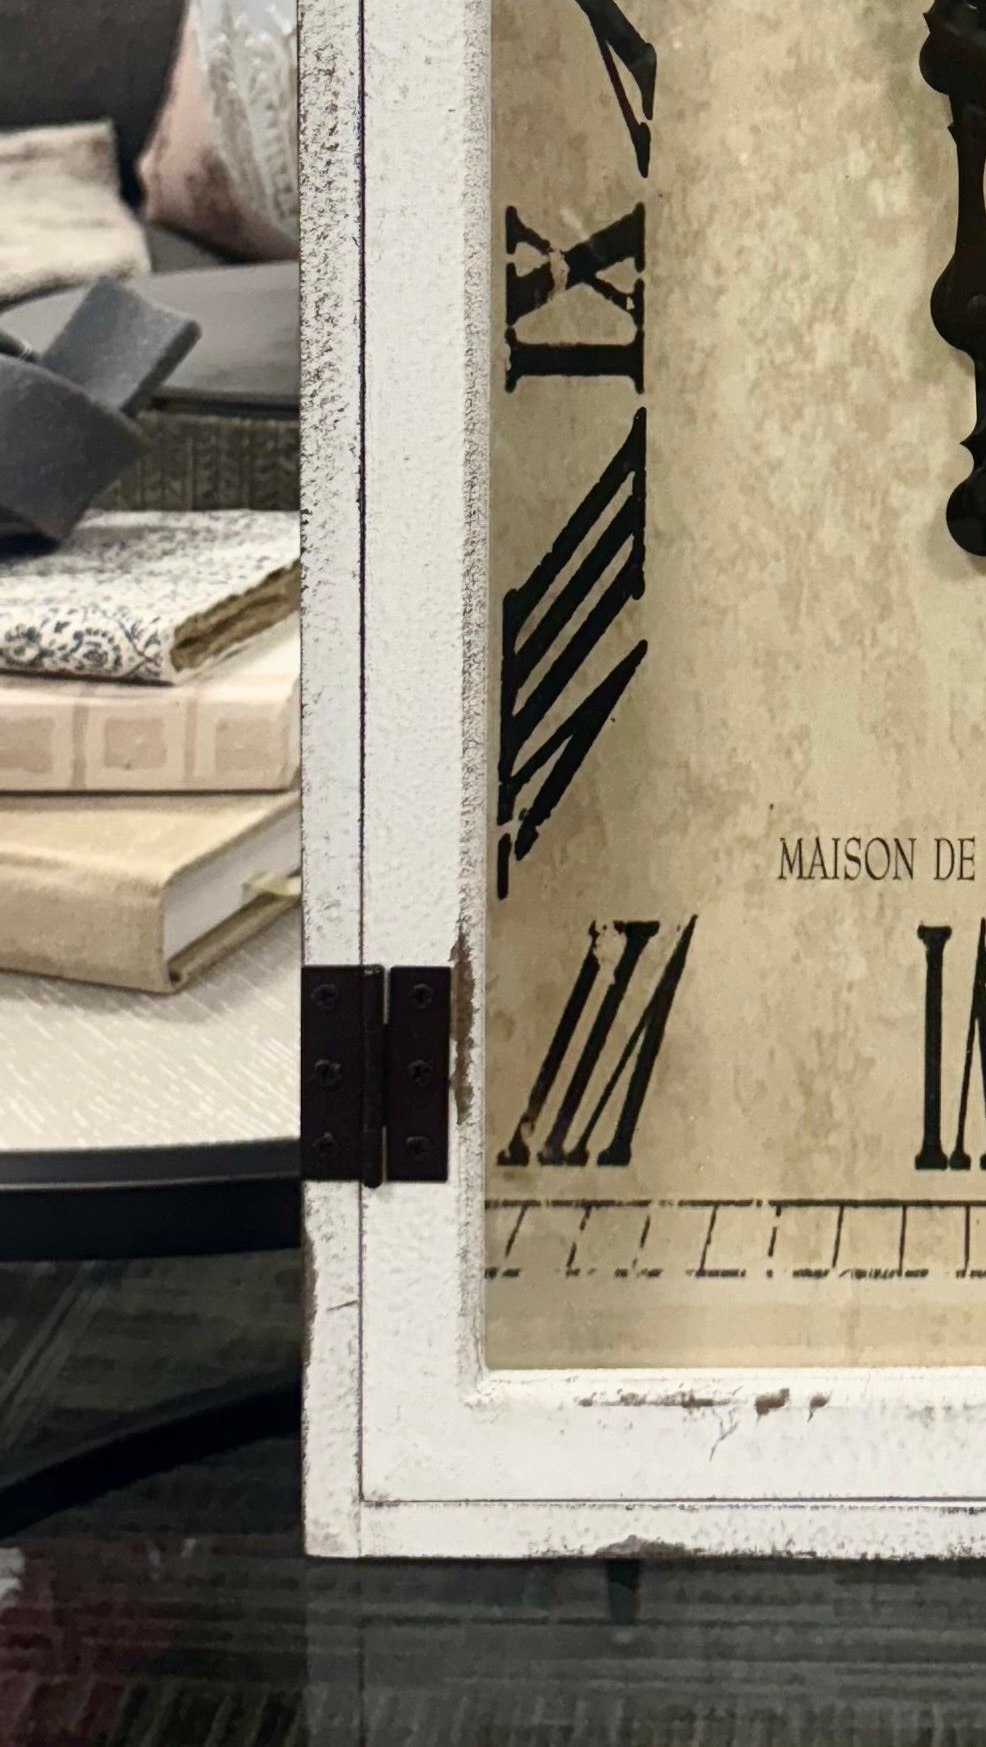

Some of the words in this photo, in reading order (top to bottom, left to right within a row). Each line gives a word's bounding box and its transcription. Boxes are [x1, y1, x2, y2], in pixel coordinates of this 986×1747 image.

[505, 201, 645, 394] IX
[777, 837, 917, 881] MAISON
[933, 836, 976, 881] DE
